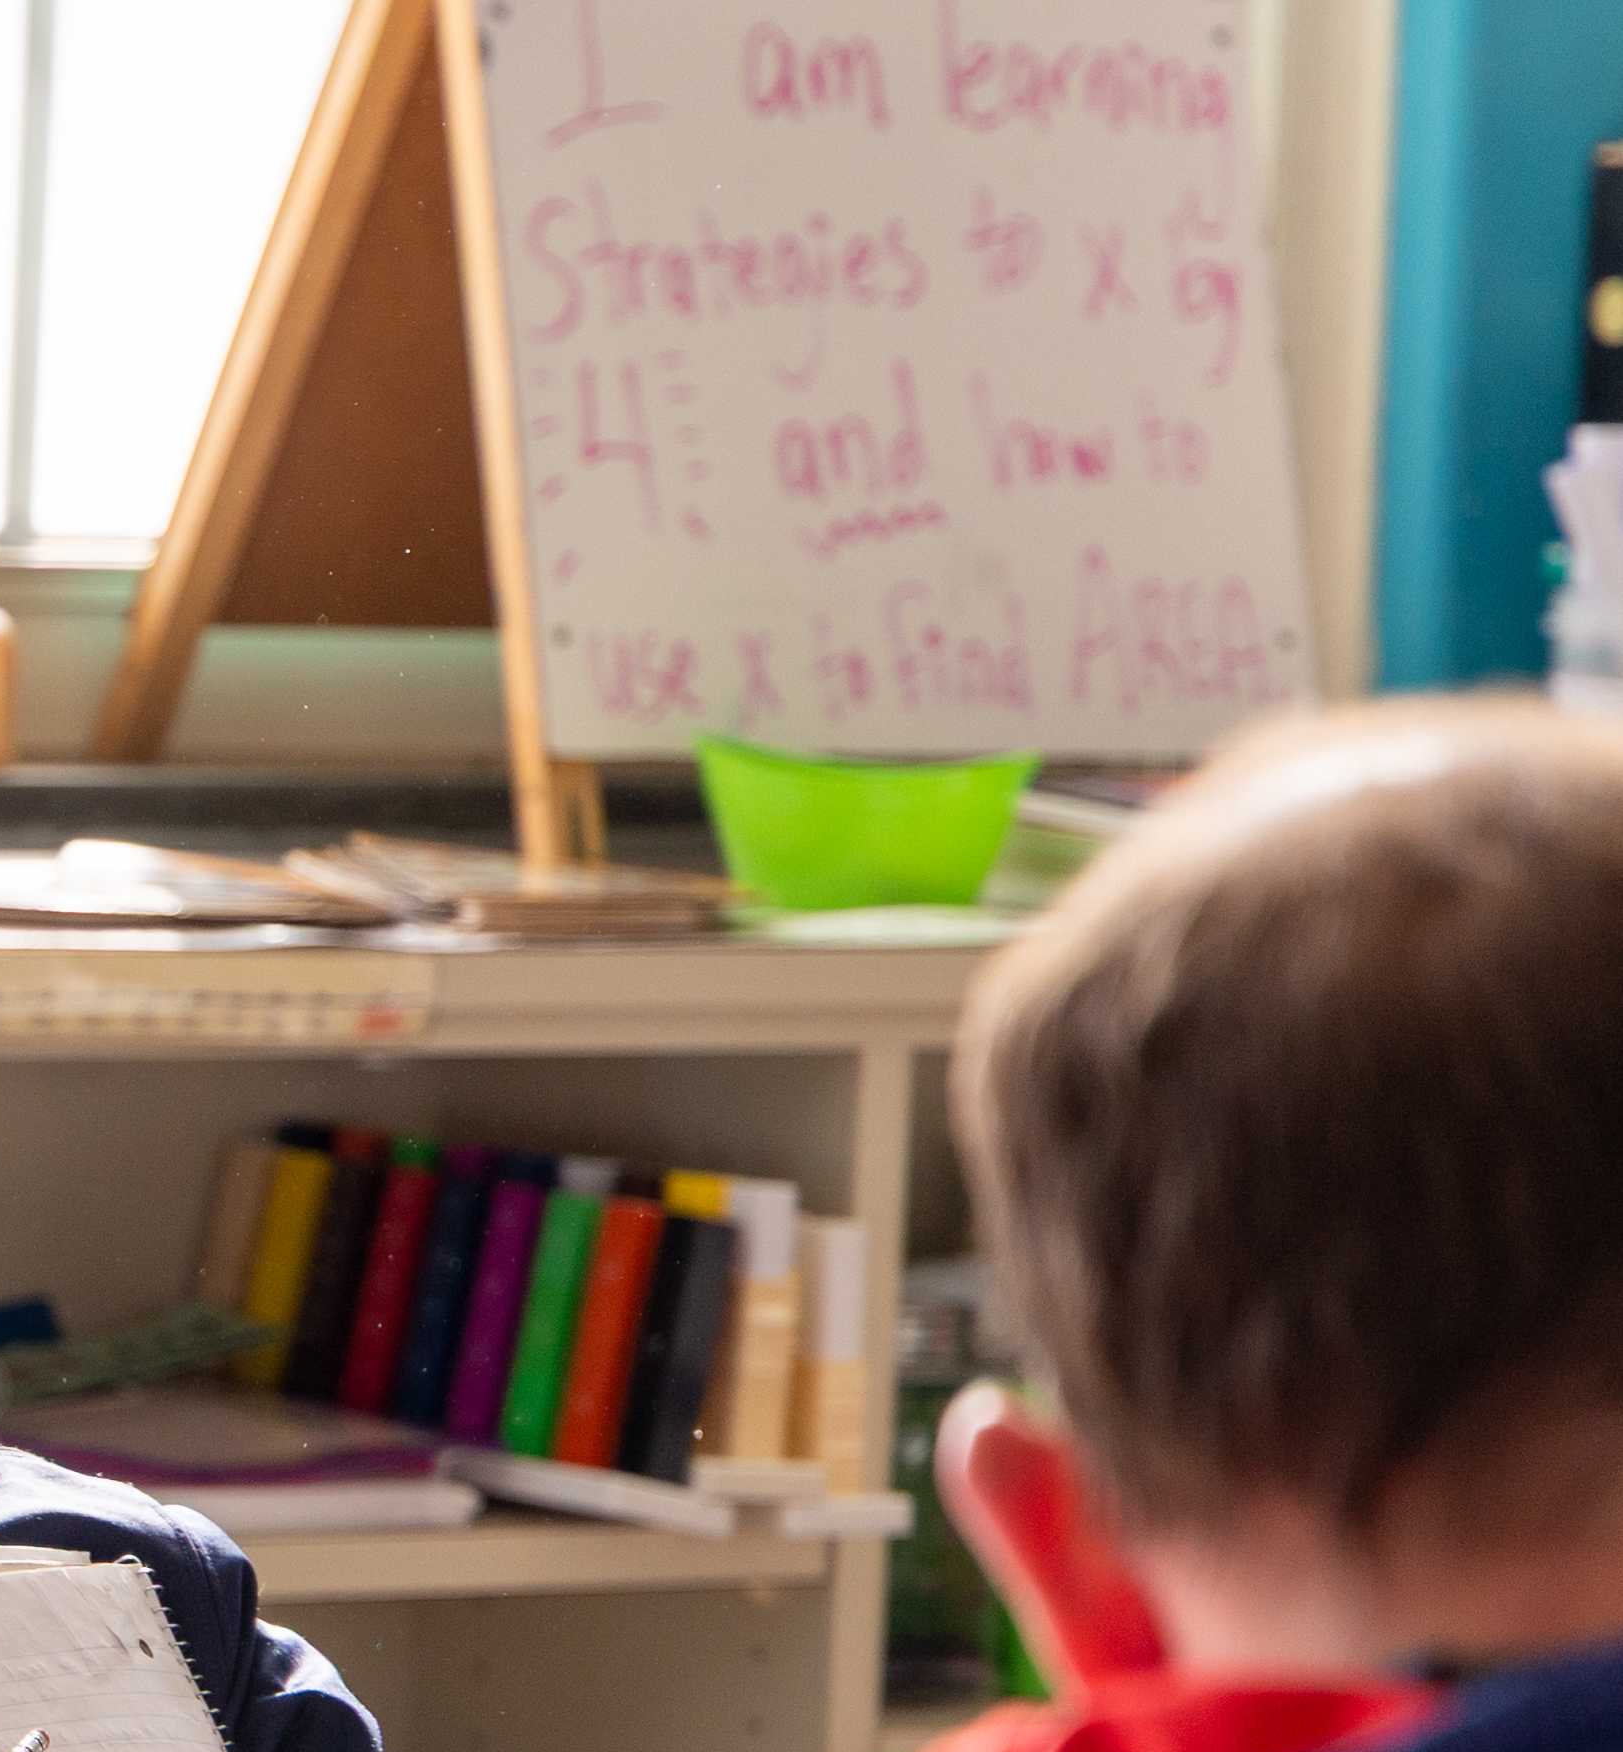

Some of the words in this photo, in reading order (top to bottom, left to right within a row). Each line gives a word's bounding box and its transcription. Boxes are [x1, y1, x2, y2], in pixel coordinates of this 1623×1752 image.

[744, 20, 892, 130] am
[964, 190, 1044, 298] to
[776, 355, 928, 502] and
[966, 368, 1116, 492] how
